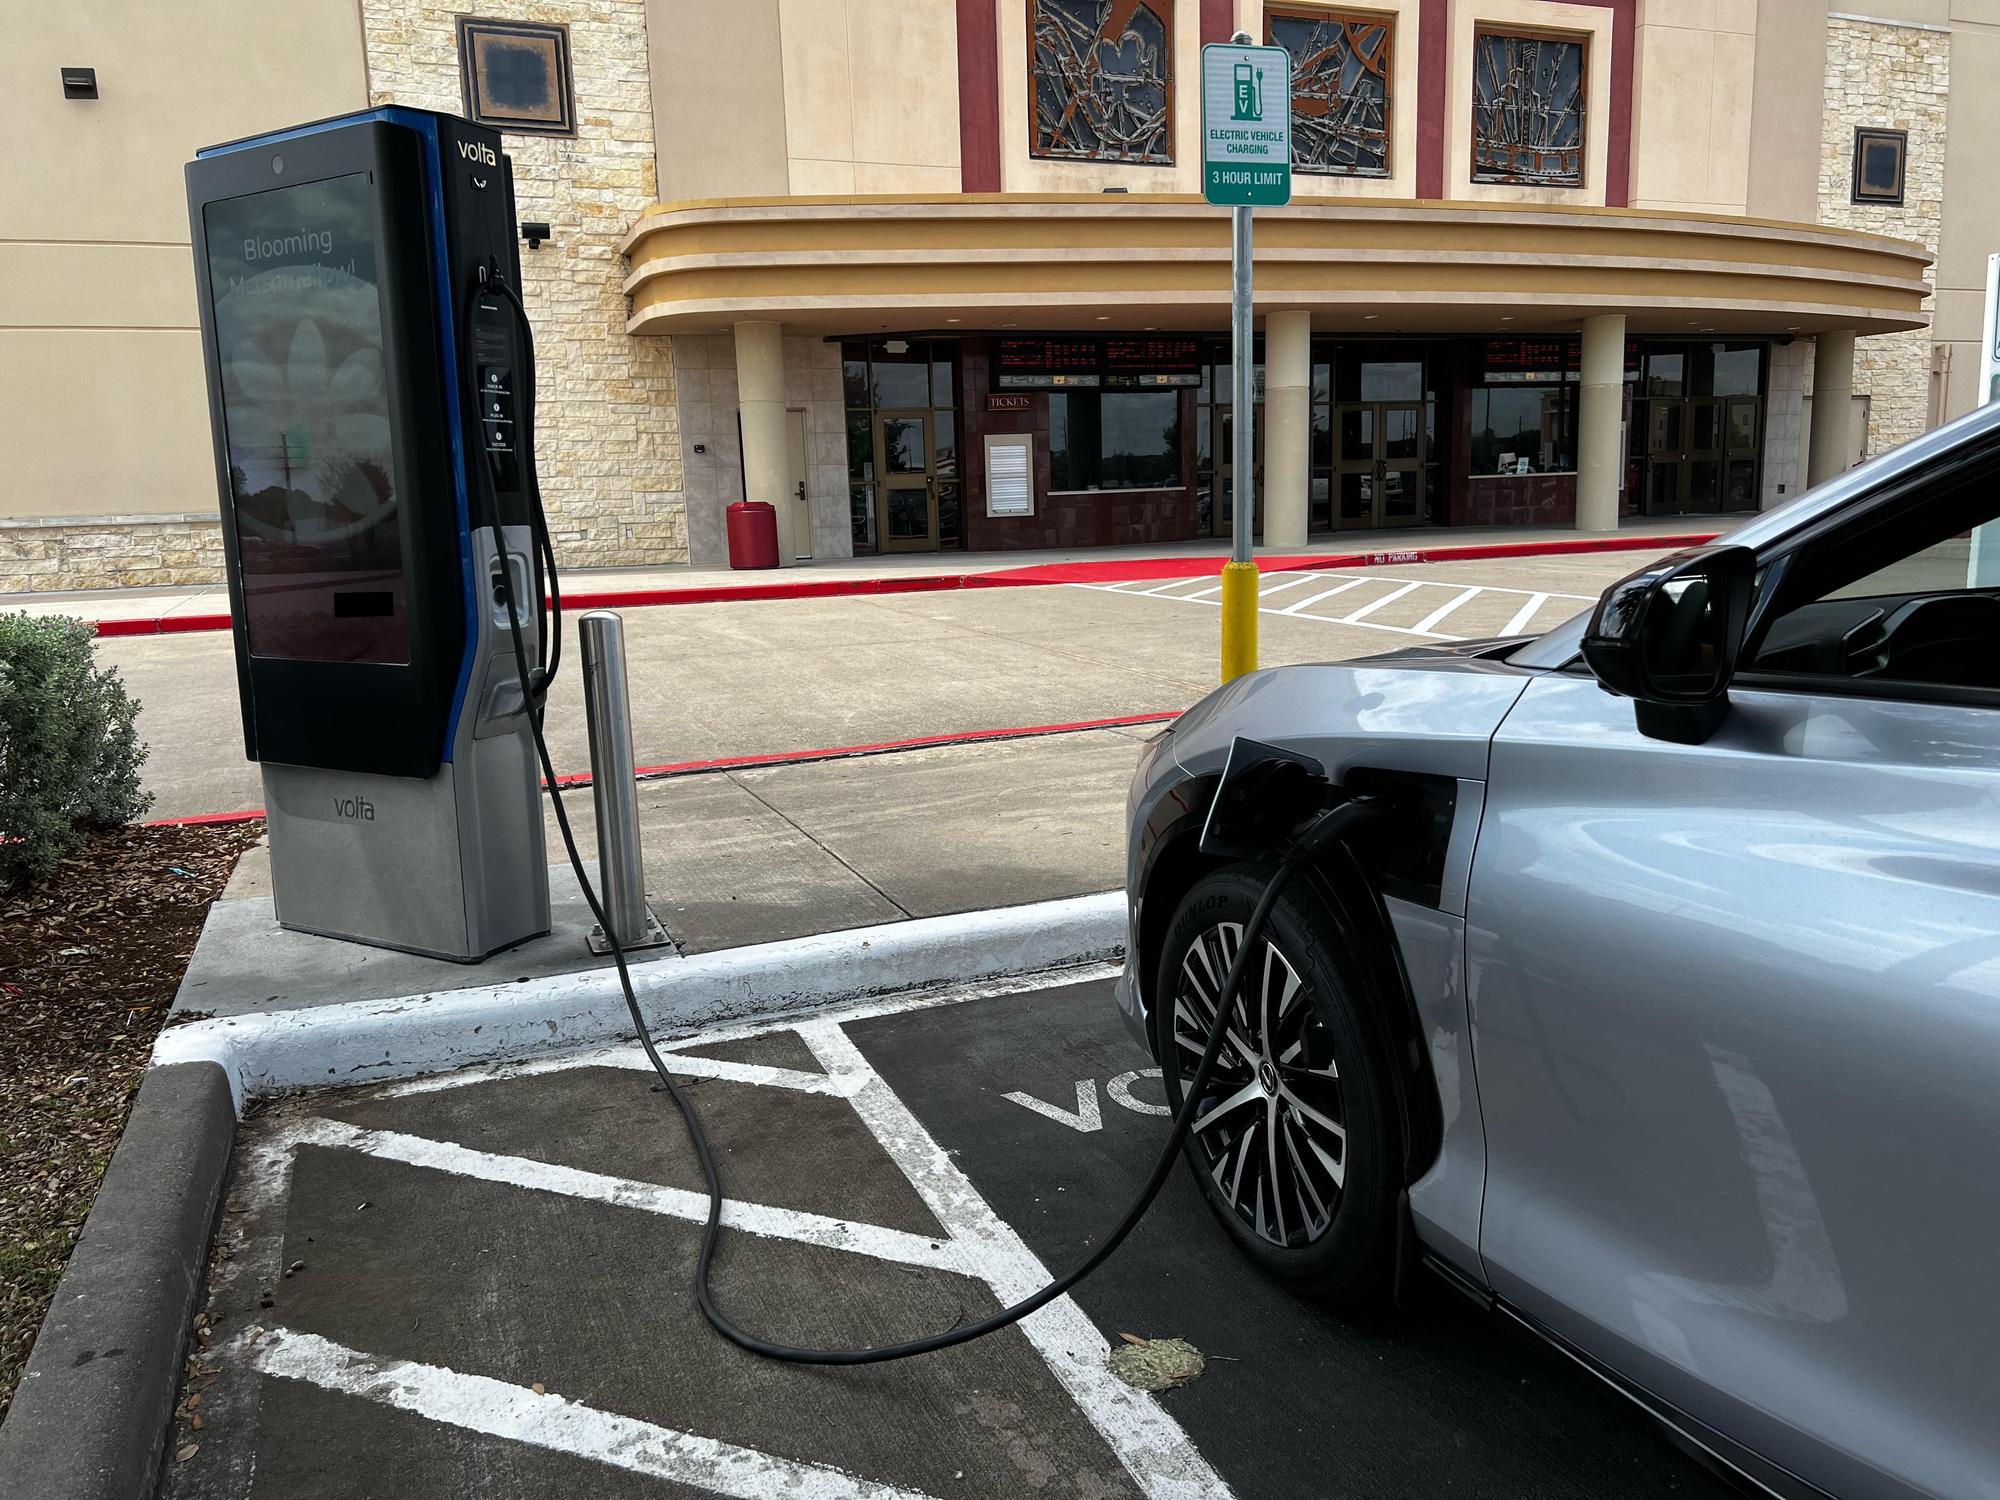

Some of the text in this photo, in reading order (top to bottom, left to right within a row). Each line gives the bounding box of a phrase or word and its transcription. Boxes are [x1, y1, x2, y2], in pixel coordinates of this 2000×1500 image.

[1239, 85, 1249, 113] EV
[1210, 129, 1284, 142] ELECTRIC VEHICLE
[457, 140, 496, 167] volta
[1226, 143, 1269, 155] CHARGING
[1212, 170, 1283, 186] 3 HOUR LIMIT
[244, 227, 333, 261] Blooming
[991, 397, 1030, 407] TICKETS
[1374, 551, 1418, 564] NO PARKING
[334, 796, 375, 821] volta
[1173, 895, 1229, 938] DUNLOP
